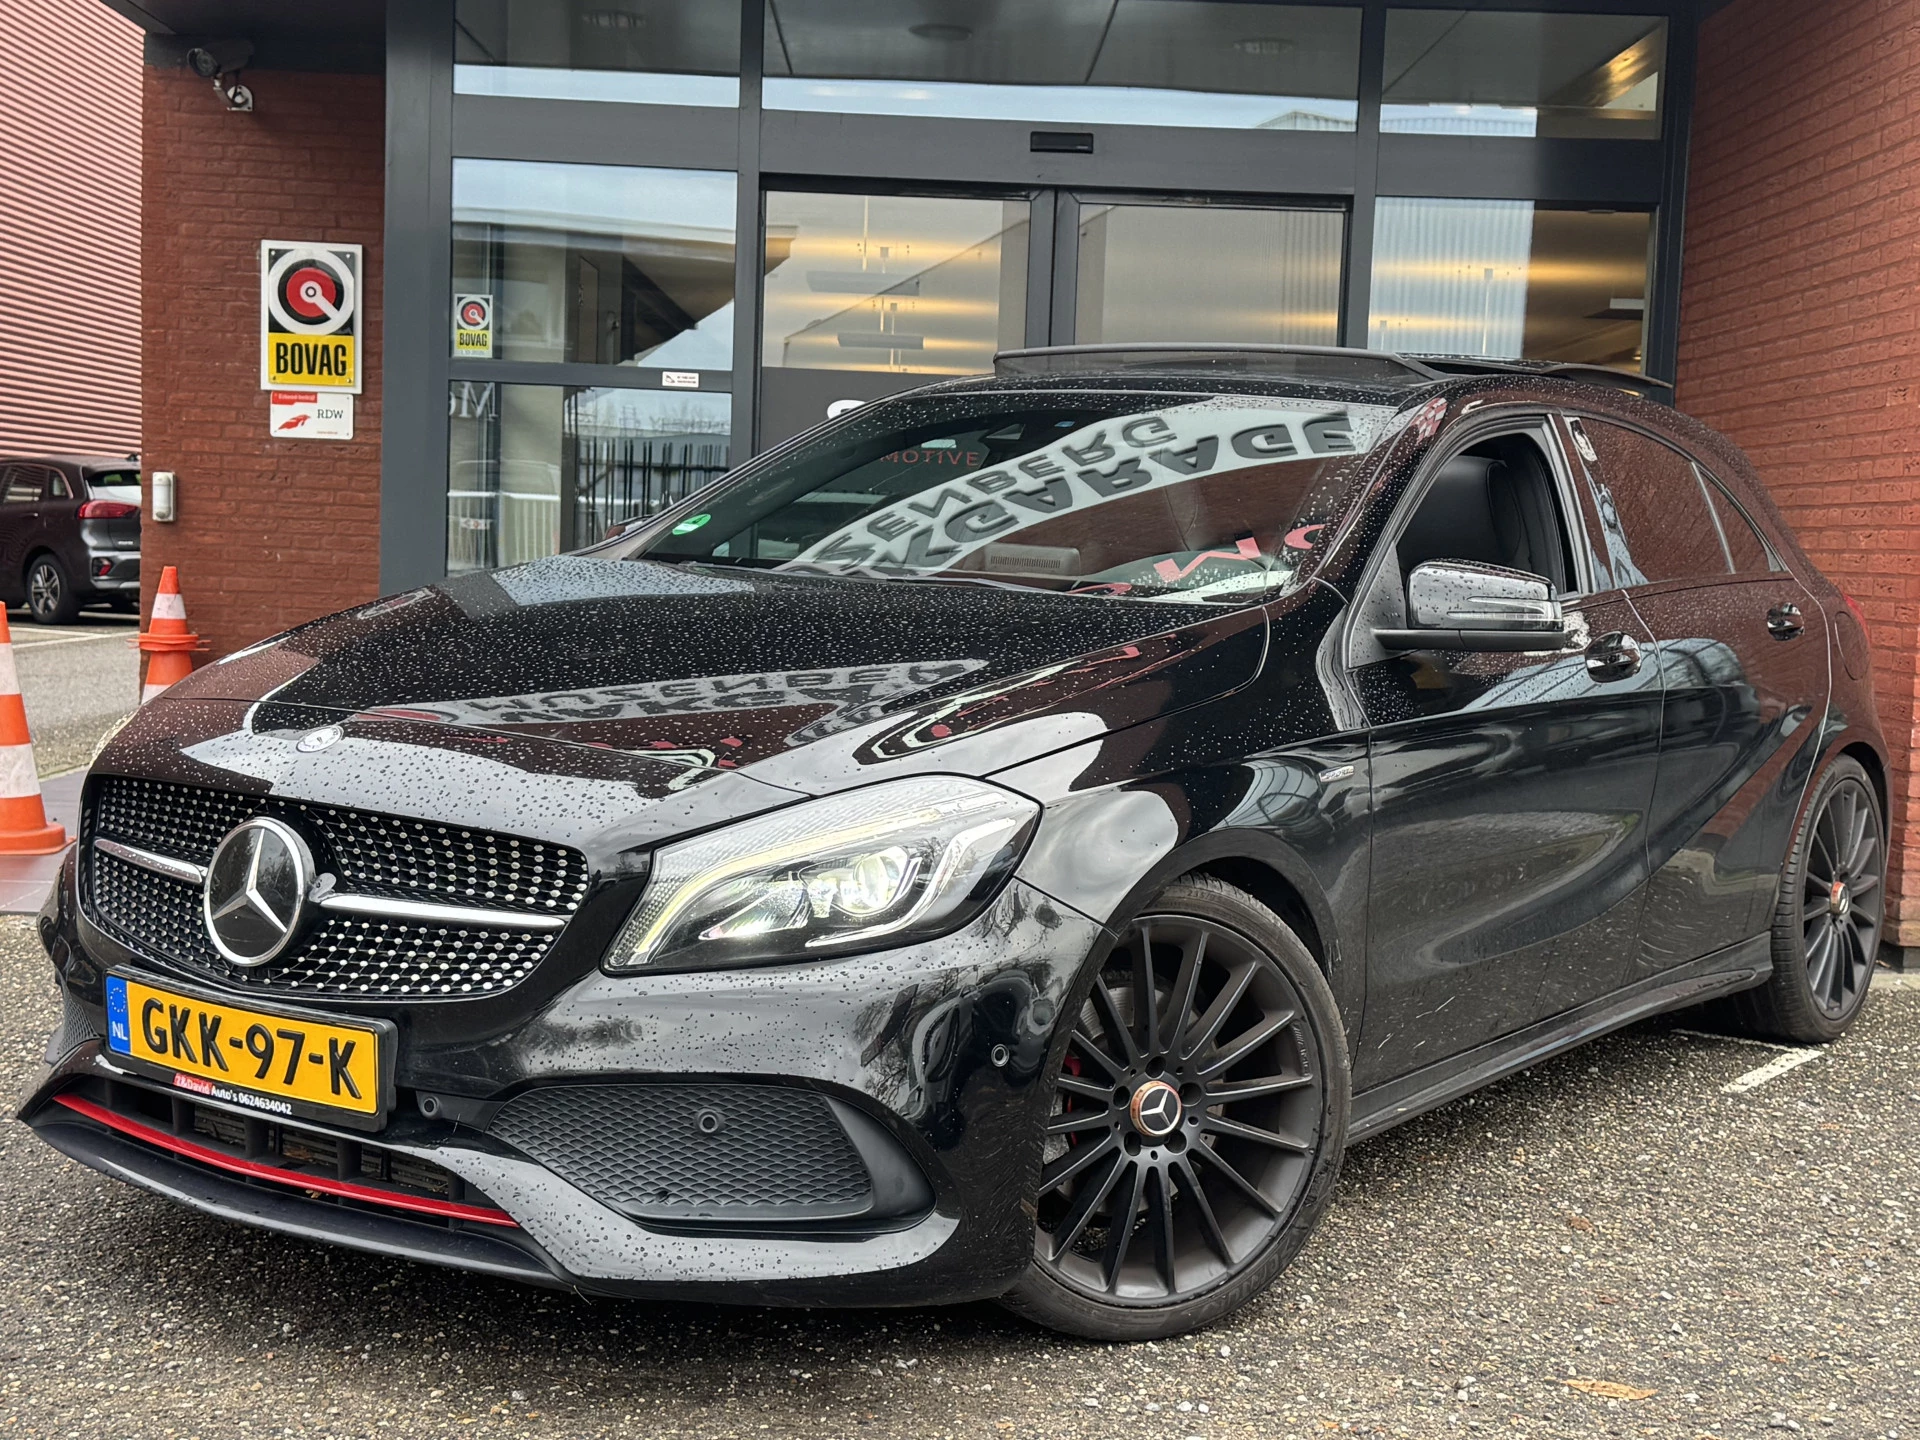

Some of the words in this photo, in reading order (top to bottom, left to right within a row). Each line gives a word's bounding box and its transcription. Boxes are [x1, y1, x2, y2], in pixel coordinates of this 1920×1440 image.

[459, 333, 488, 347] BOVAG
[276, 342, 347, 377] BOVAG
[317, 409, 344, 419] RDW
[112, 1021, 129, 1041] NL
[142, 997, 362, 1100] GKK-97-K
[211, 1085, 238, 1102] Auto's
[239, 1092, 293, 1115] 0624634042
